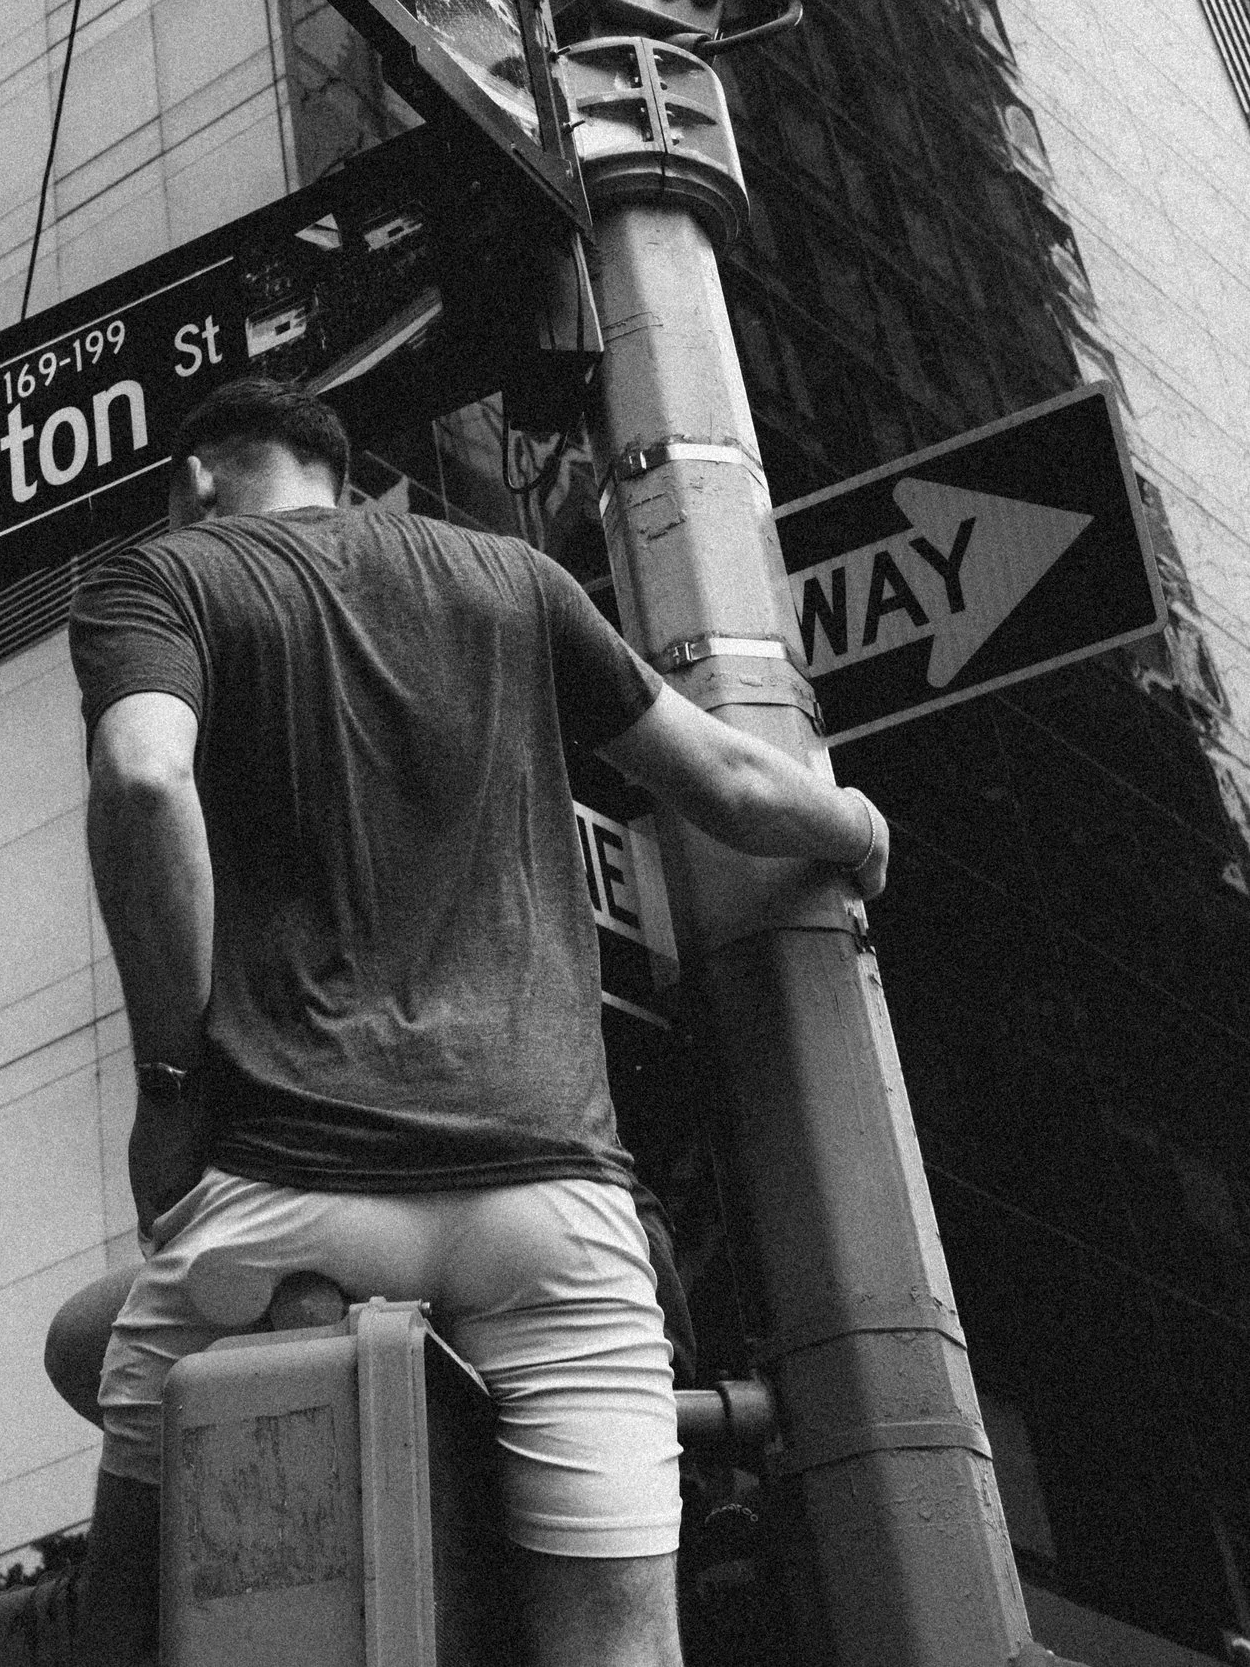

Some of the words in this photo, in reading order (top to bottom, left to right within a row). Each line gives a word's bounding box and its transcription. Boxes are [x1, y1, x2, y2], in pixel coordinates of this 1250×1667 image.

[4, 319, 127, 404] 169-199
[174, 315, 224, 377] St
[794, 516, 976, 667] WAY
